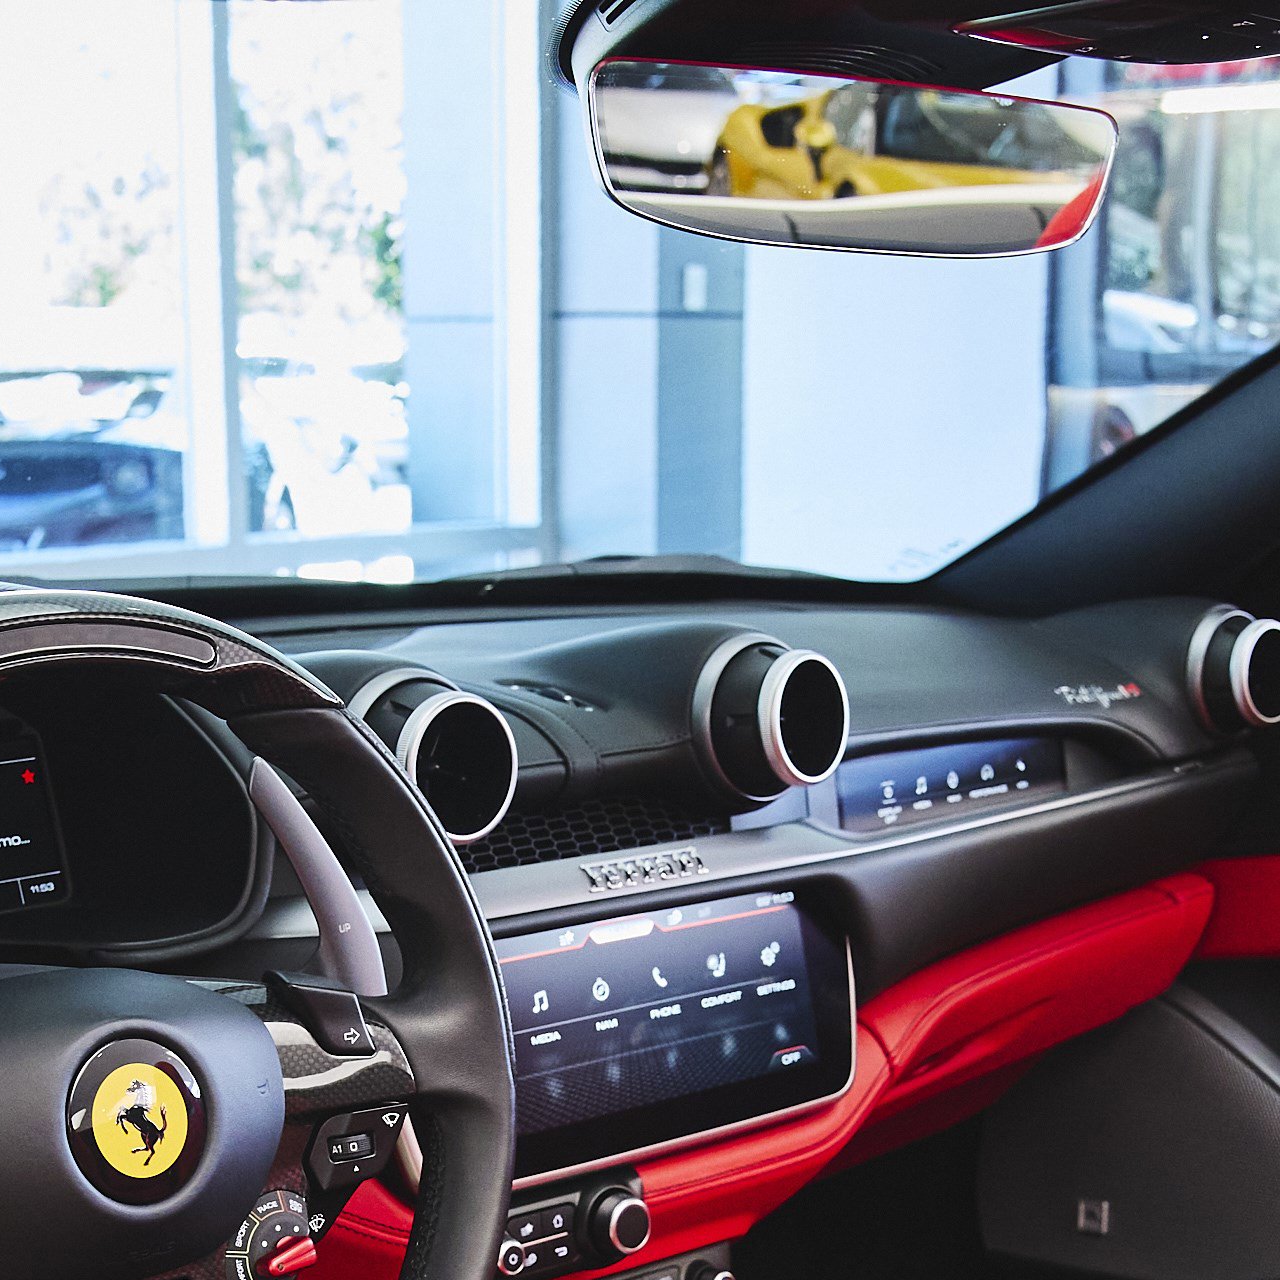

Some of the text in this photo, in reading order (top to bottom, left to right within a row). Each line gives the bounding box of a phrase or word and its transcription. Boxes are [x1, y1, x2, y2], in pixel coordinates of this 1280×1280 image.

[579, 846, 710, 893] Ferrari
[339, 922, 351, 933] UP
[530, 1031, 562, 1046] MEDIA
[257, 1200, 279, 1214] RACE
[235, 1220, 250, 1248] SPORT
